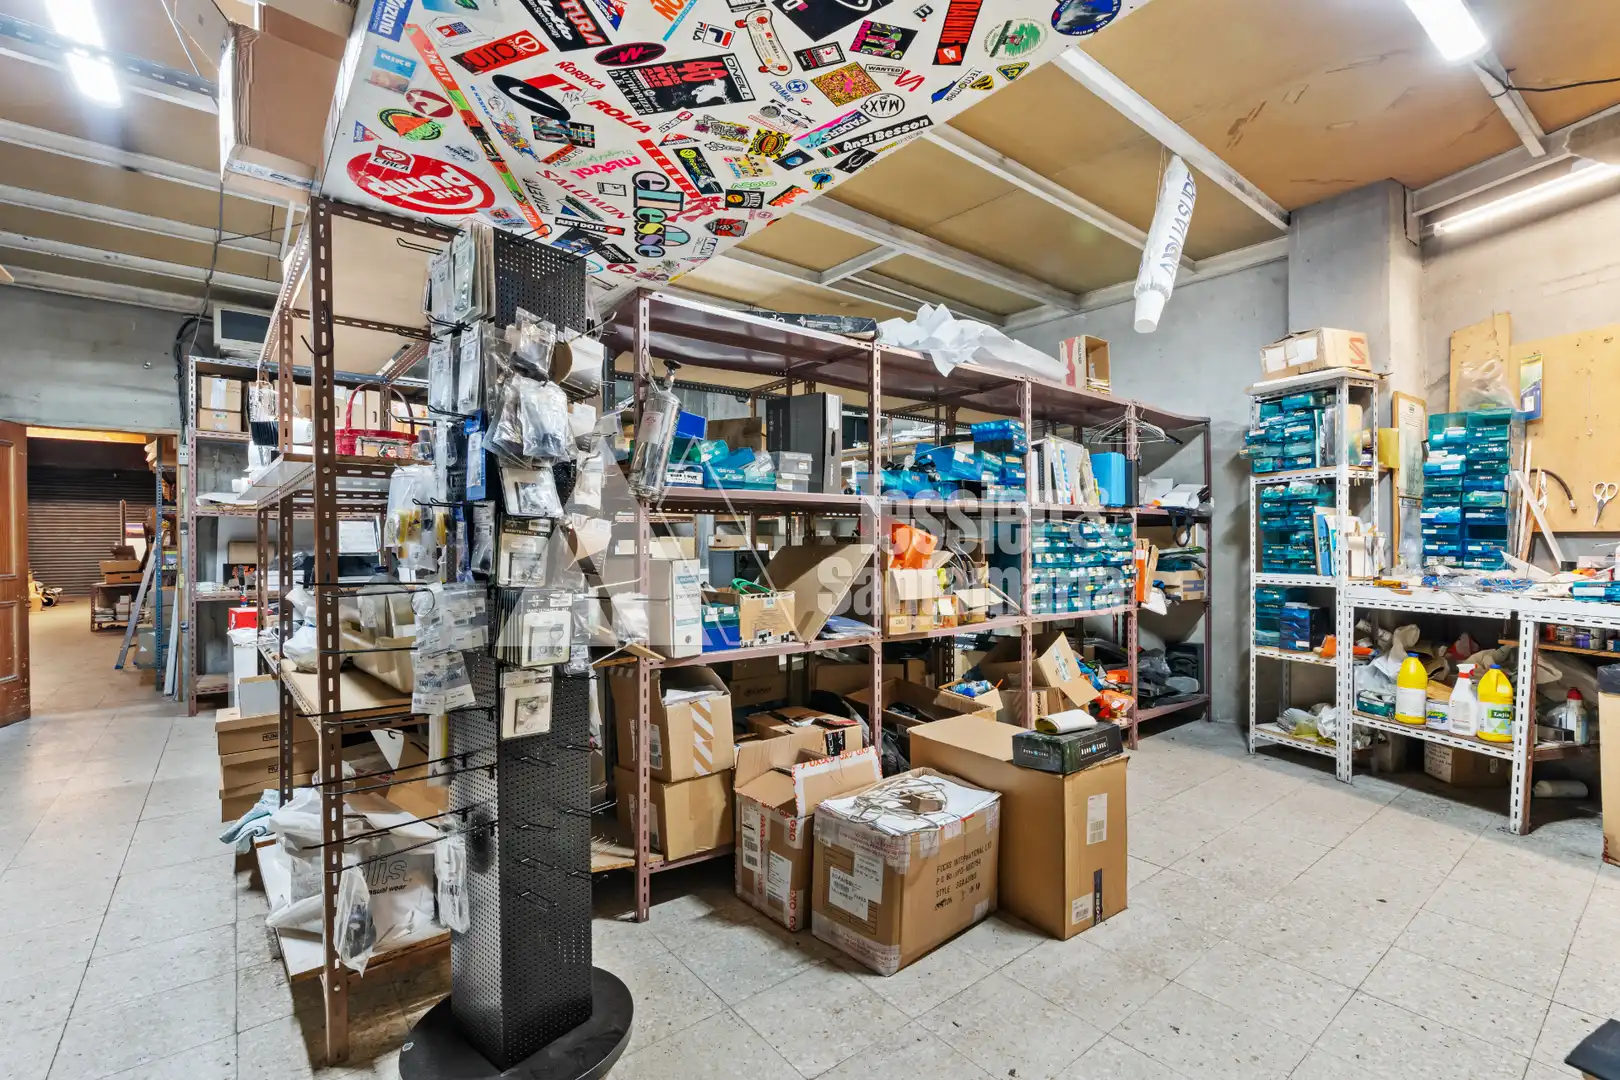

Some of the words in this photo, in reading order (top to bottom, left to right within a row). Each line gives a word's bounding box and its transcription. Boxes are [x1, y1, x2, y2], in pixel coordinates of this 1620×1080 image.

[693, 21, 706, 41] FILA
[555, 61, 606, 91] NORDICA
[868, 64, 901, 73] WANTED
[608, 70, 645, 116] DEALER
[618, 69, 654, 114] AUTHORIZED
[770, 80, 794, 103] COLMAR
[869, 99, 900, 113] MAX
[822, 114, 865, 142] FADERS
[843, 134, 873, 151] Anzi
[875, 118, 929, 141] Besson
[373, 157, 410, 172] CIRCA
[569, 155, 642, 180] mistral
[428, 189, 468, 200] THE
[536, 170, 631, 220] SALOMON
[557, 219, 580, 228] JUST
[580, 223, 592, 231] DO
[632, 170, 685, 258] ellesse
